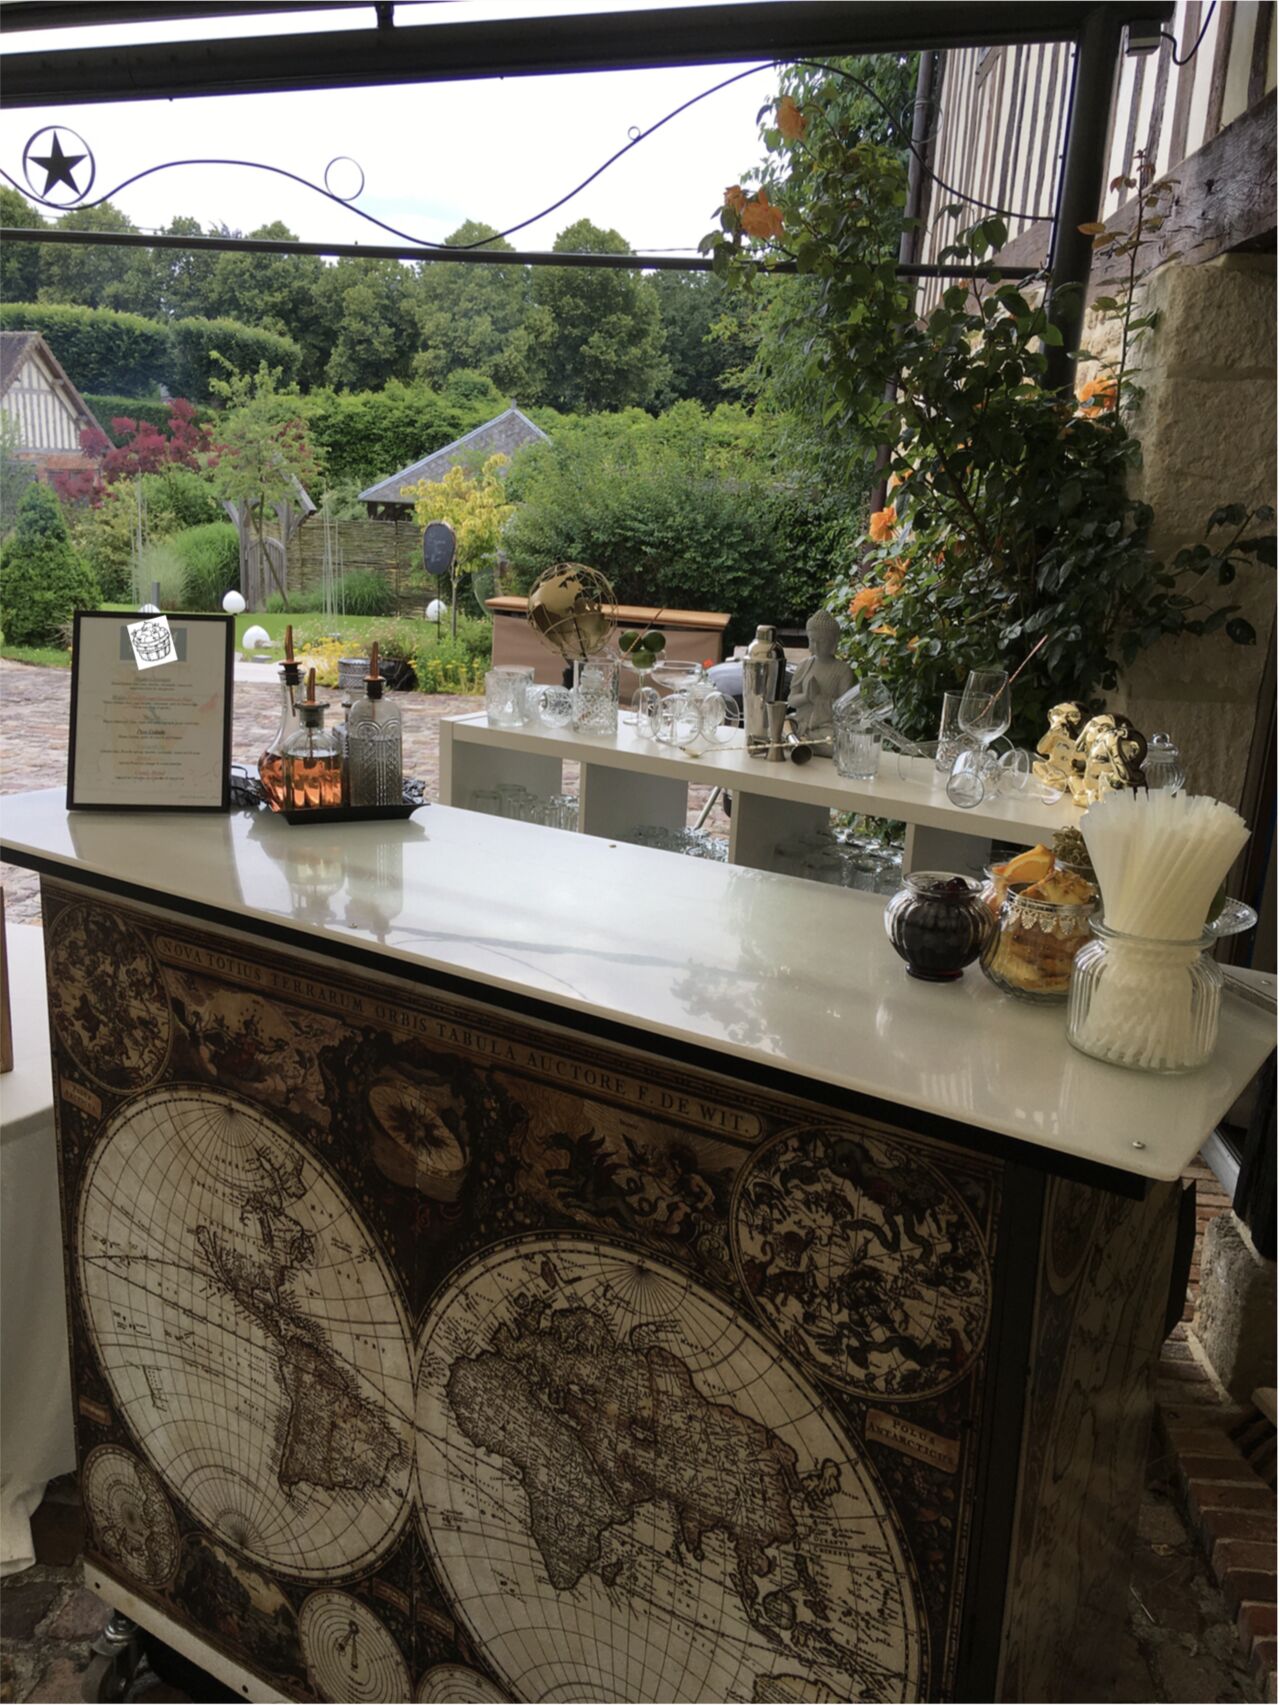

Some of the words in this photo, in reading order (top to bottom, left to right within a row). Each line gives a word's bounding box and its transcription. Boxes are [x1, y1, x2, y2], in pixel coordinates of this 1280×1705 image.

[162, 940, 201, 964] NOVA
[206, 951, 262, 982] TOTIUS
[271, 973, 364, 1013] TERRARUM
[375, 1004, 427, 1032] ORBIS
[436, 1021, 516, 1061] TABULA
[527, 1053, 626, 1096] AUCTORE
[661, 1092, 690, 1115] DE
[700, 1108, 750, 1134] WIT.
